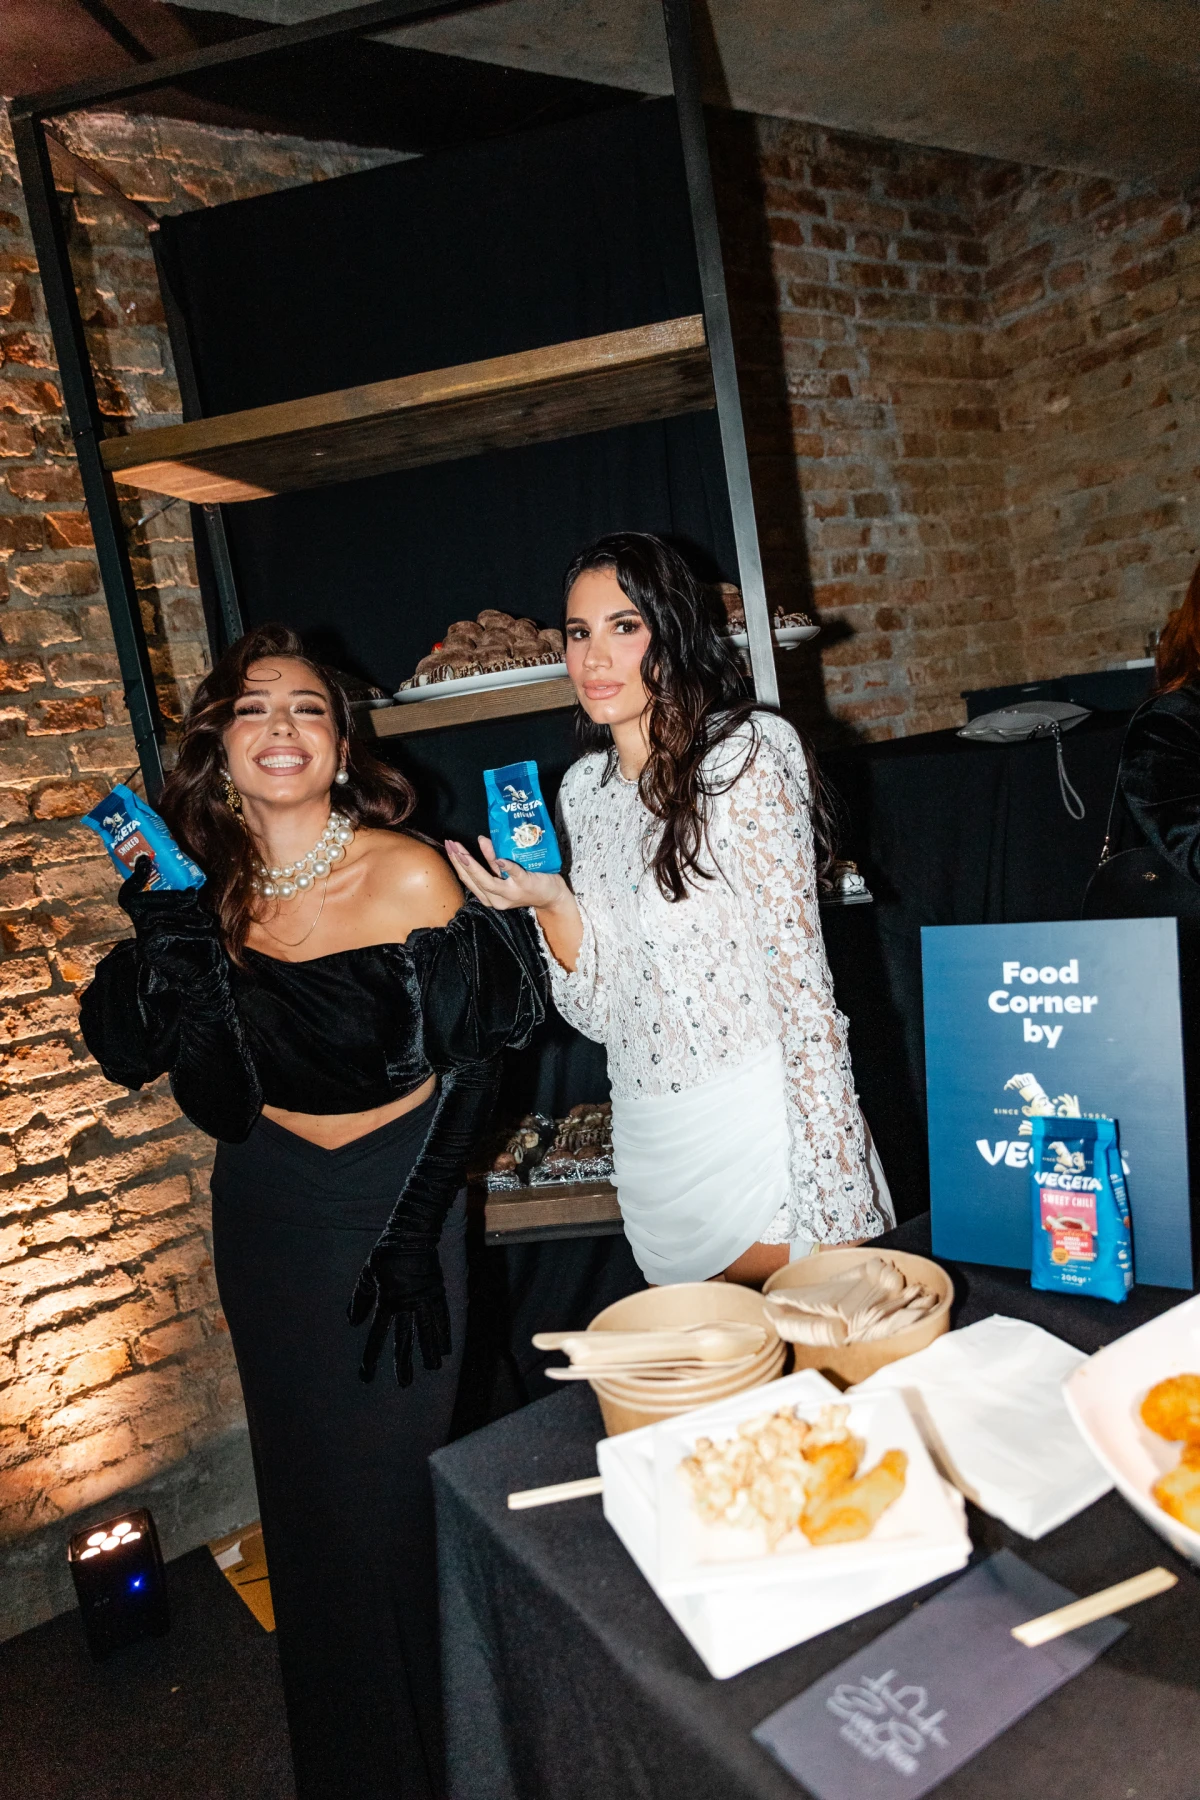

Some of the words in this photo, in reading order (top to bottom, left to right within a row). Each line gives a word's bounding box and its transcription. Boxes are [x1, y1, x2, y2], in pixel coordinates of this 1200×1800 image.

[501, 799, 543, 813] VEGETA
[118, 836, 140, 856] SMOKED
[1003, 959, 1079, 984] Food
[988, 990, 1098, 1014] Corner
[1023, 1018, 1063, 1049] by
[994, 1108, 1019, 1116] SINCE
[1033, 1170, 1103, 1191] VEGETA
[1042, 1193, 1069, 1206] SWEET
[1071, 1196, 1094, 1208] CHILI
